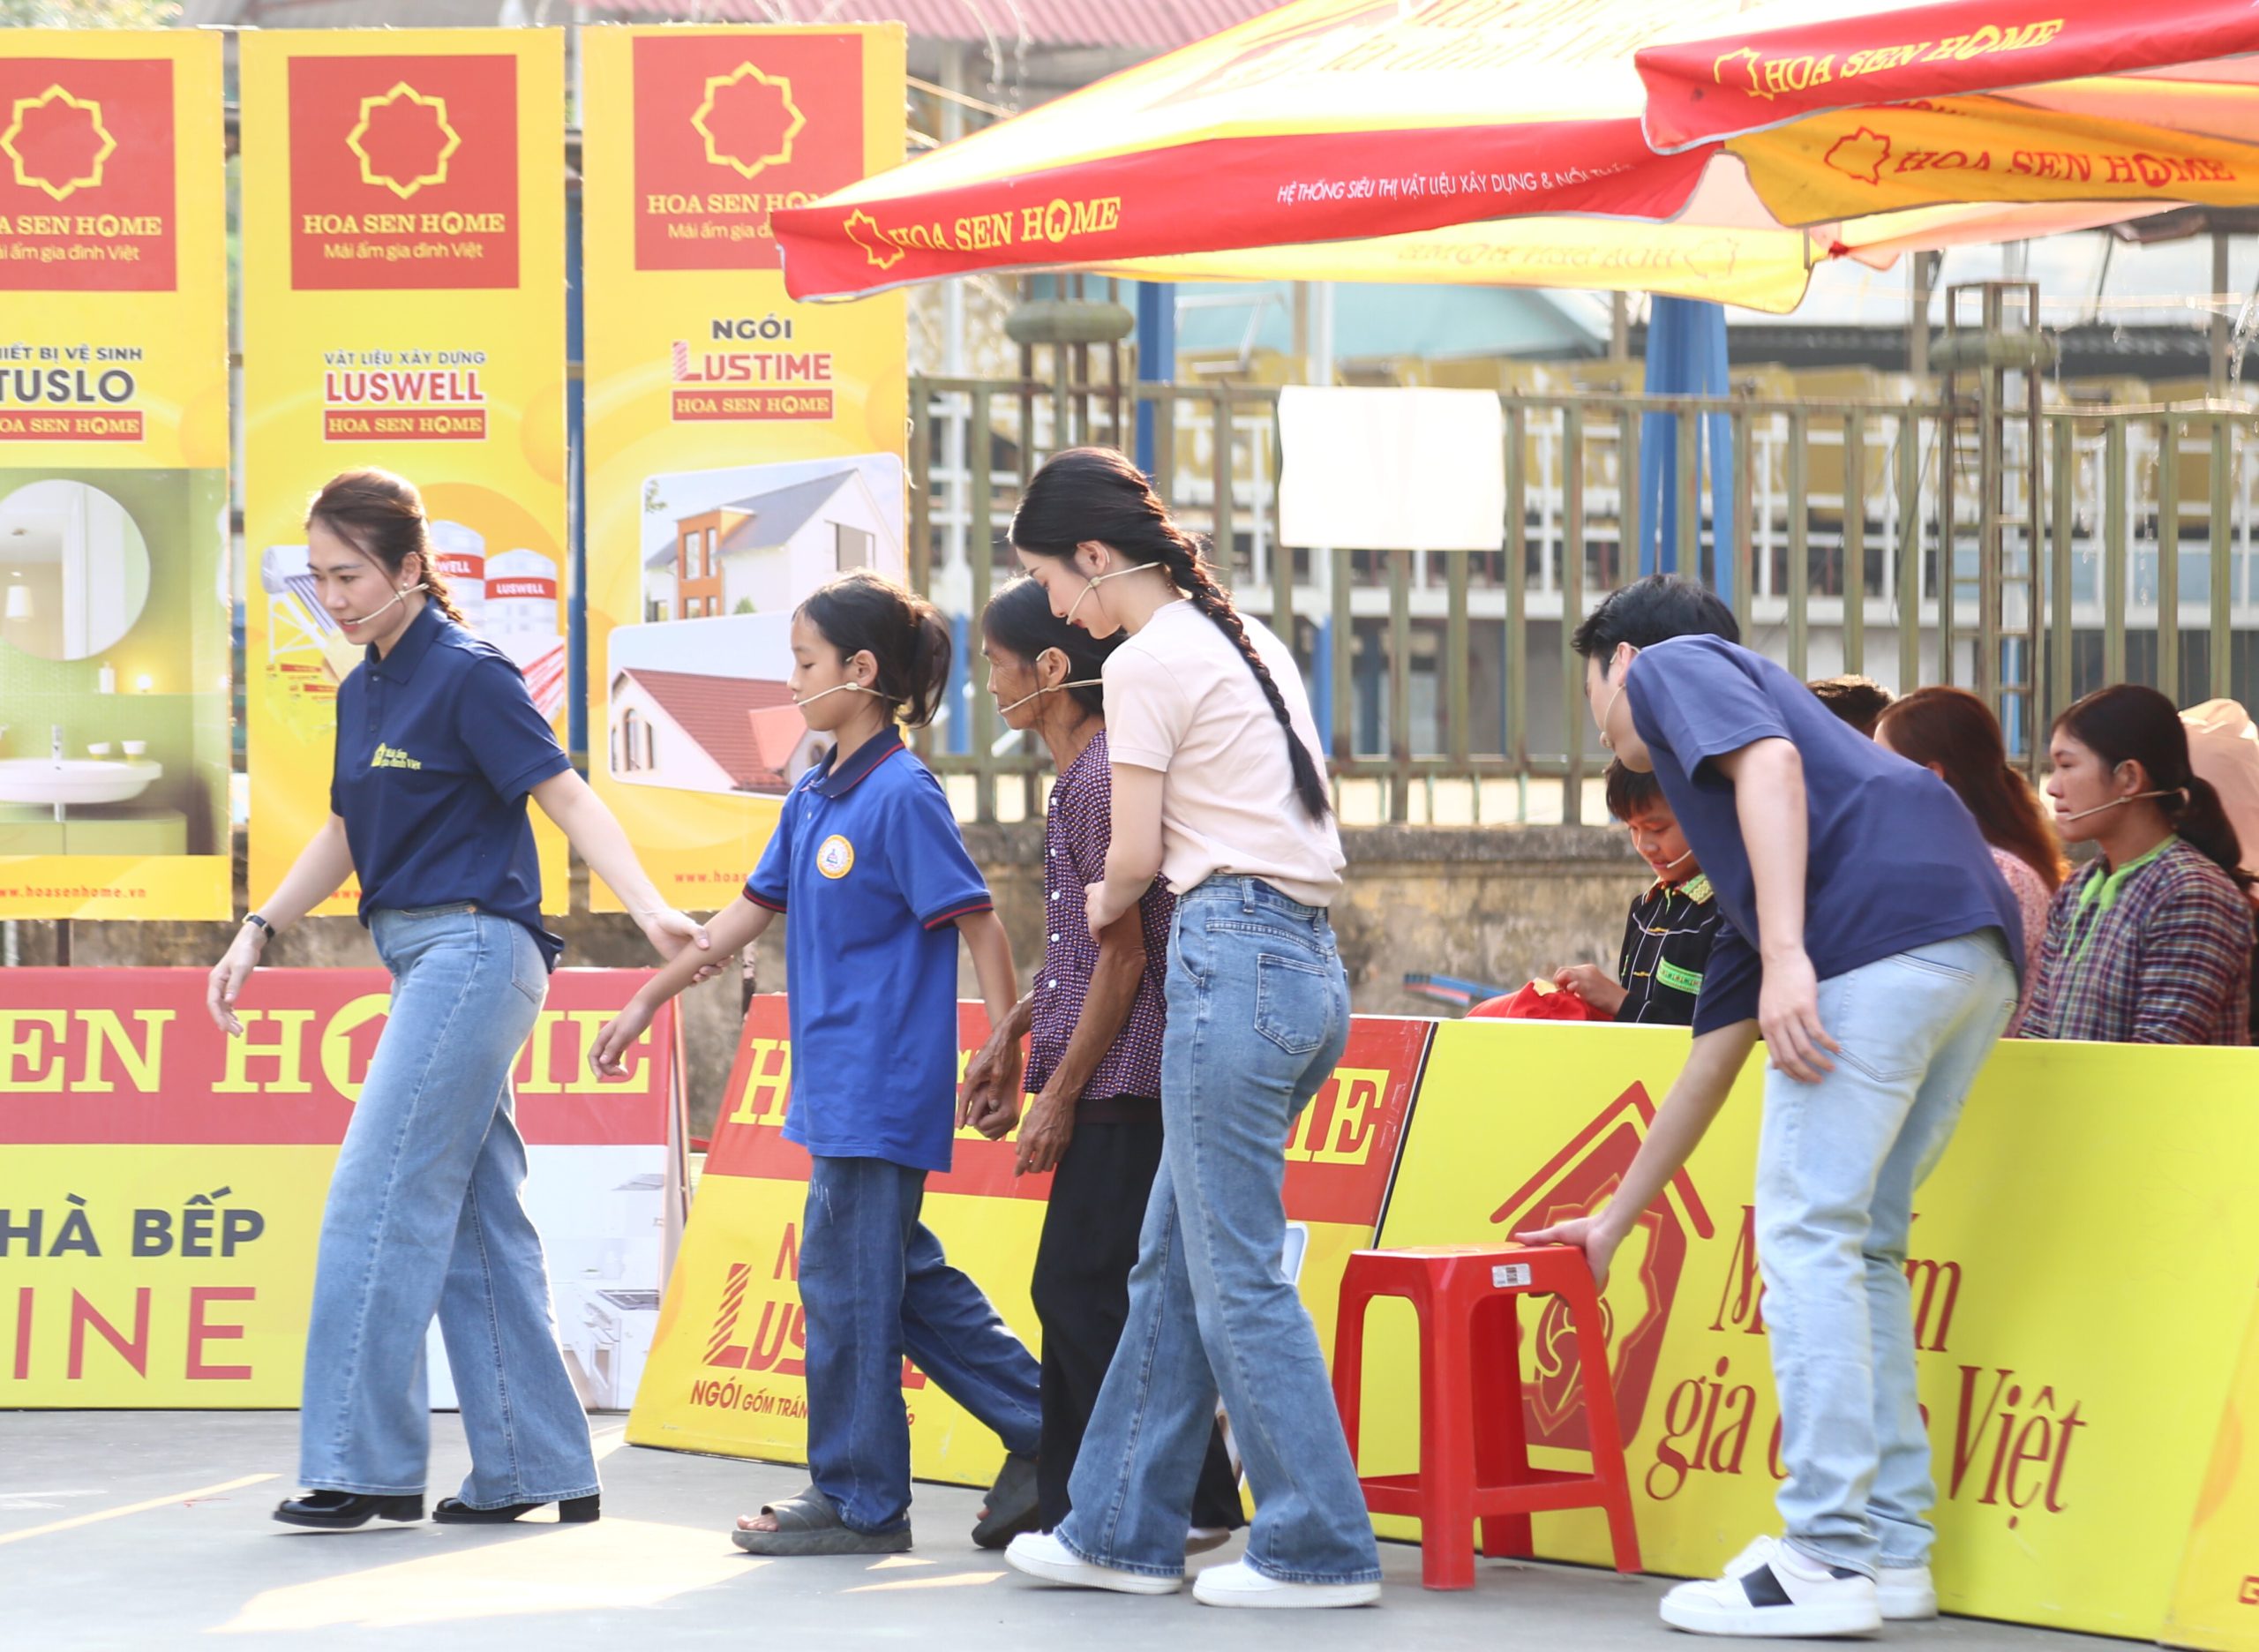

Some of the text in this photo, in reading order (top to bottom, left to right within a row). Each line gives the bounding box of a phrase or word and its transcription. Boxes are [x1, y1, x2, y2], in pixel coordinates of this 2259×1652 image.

[1764, 19, 2065, 93] HOA SEN HOME
[1893, 151, 2237, 187] HOA SEN HOME
[1277, 180, 1296, 206] HỆ
[1297, 179, 1346, 201] THỐNG
[1347, 176, 1376, 199] SIÊU
[1377, 177, 1399, 201] THỊ
[1400, 173, 1426, 199] VẬT
[1428, 171, 1456, 198] LIỆU
[1459, 170, 1487, 193] XÂY
[1490, 172, 1537, 195] DỰNG
[1541, 171, 1553, 190] &
[647, 194, 704, 214] HOA
[707, 193, 760, 214] SEN
[17, 214, 71, 236] SEN
[74, 214, 162, 237] HOME
[302, 211, 506, 235] HOA SEN HOME
[668, 222, 698, 239] Mái
[700, 221, 728, 239] ấm
[730, 222, 755, 242] gia
[888, 197, 1121, 251] HOA SEN HOME
[10, 242, 38, 260] ấm
[40, 244, 66, 263] gia
[67, 244, 105, 260] đình
[106, 244, 140, 263] Việt
[323, 239, 484, 262] Mái ấm gia đình Việt
[712, 313, 792, 340] NGÓI
[40, 347, 58, 364] BỊ
[64, 343, 90, 364] VỆ
[96, 348, 142, 360] SINH
[324, 349, 485, 368] VẬT LIỆU XÂY DỰNG
[673, 342, 831, 381] LUSTIME
[326, 372, 484, 402] LUSWELL
[676, 395, 829, 414] HOA SEN HOME
[0, 417, 139, 435] OA SEN HOME
[328, 416, 482, 433] HOA SEN HOME
[435, 560, 471, 574] WELL
[496, 583, 545, 595] LUSWELL
[0, 1009, 176, 1093] EN
[0, 1185, 265, 1258] HÀ BẾP
[689, 1376, 807, 1420] NGÓI GỐM TRÁN
[1645, 1356, 1757, 1501] gia
[1948, 1364, 2088, 1529] Việt
